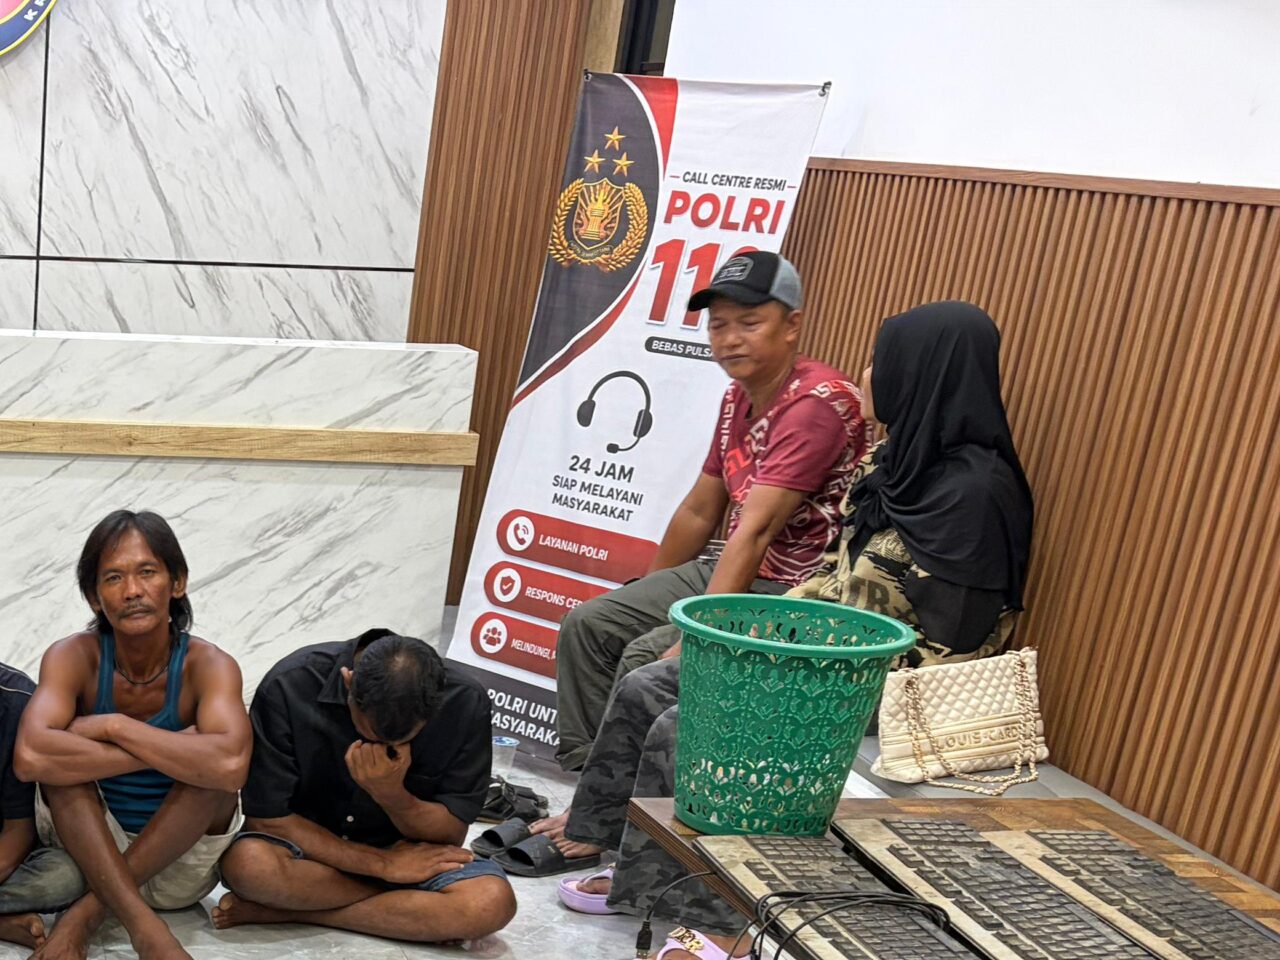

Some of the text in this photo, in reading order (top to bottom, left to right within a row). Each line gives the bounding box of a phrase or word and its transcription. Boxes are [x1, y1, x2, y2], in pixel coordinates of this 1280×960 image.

[682, 171, 787, 191] CALL CENTRE RESMI
[663, 190, 786, 234] POLRI
[647, 238, 760, 329] 11
[651, 340, 684, 353] BEBAS
[569, 455, 634, 483] 24 JAM
[552, 475, 644, 506] SIAP MELAYANI
[551, 492, 634, 521] MASYARAKAT
[539, 534, 609, 561] LAYANAN POLRI
[524, 586, 566, 606] RESPONS
[487, 688, 558, 725] POLRI UNT
[490, 710, 560, 747] ASYARAK
